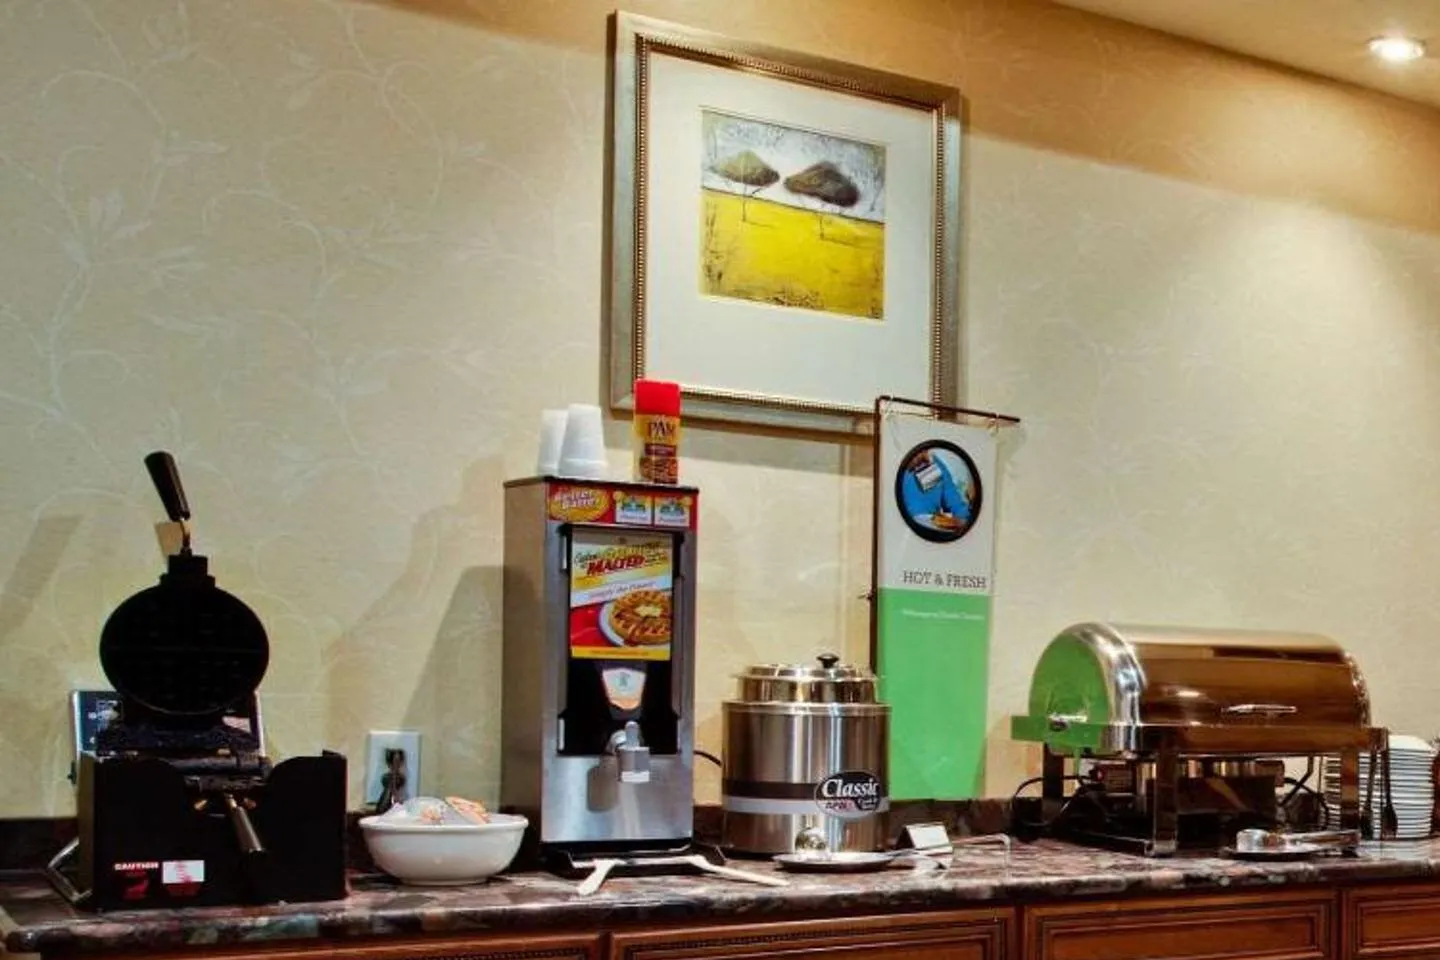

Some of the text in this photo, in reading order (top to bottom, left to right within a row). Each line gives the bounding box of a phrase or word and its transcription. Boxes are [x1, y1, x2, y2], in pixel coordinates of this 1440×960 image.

[645, 419, 676, 436] PAM
[587, 554, 647, 576] MALTED
[903, 570, 987, 589] HOT & FRESH
[821, 777, 879, 798] Classic
[115, 861, 159, 871] CAUTION
